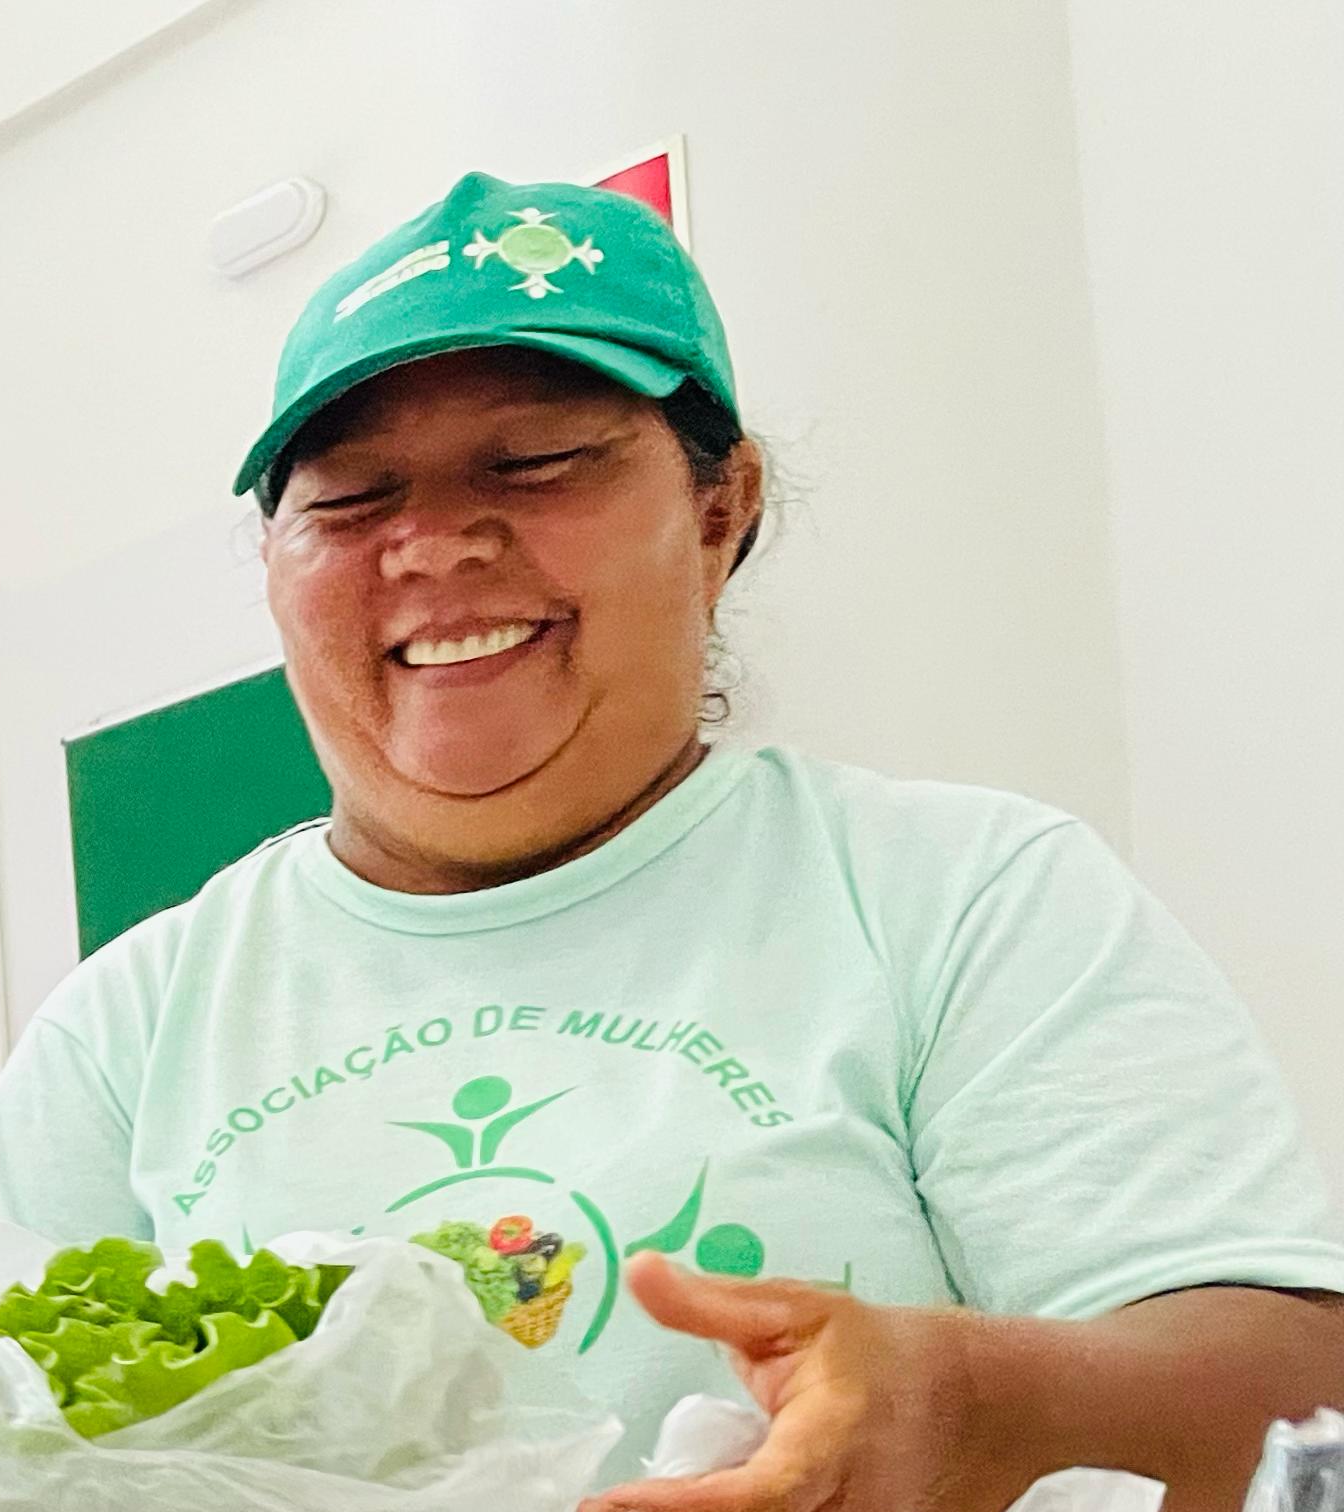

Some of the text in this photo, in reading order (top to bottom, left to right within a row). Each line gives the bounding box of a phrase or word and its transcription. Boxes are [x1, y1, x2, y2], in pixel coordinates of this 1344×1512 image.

[173, 1004, 795, 1216] ASSOCIAÇÃO DE MULHERES
